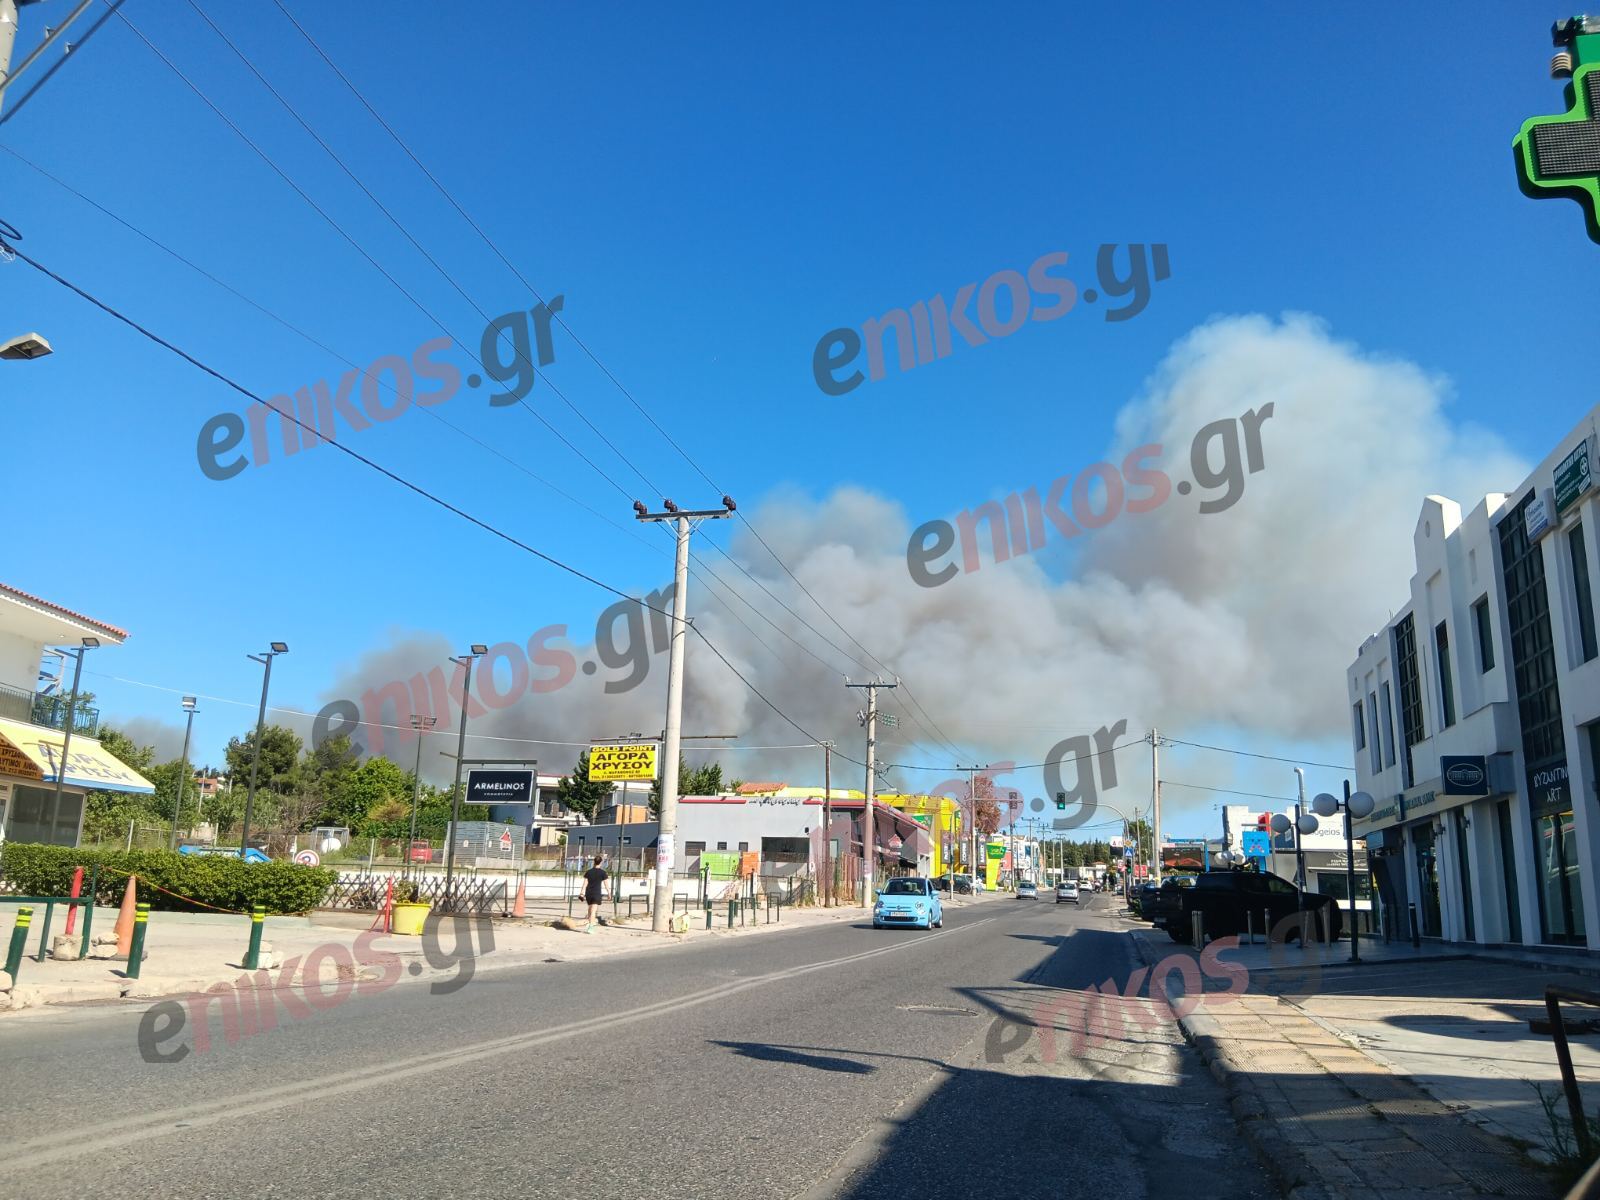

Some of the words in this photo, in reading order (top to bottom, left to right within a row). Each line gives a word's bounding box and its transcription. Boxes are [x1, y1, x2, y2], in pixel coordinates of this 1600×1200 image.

[596, 752, 649, 761] ΑΓΟΡΑ
[591, 761, 653, 770] ΧΡΥΣΟΥ
[474, 782, 525, 790] ARMELINOS
